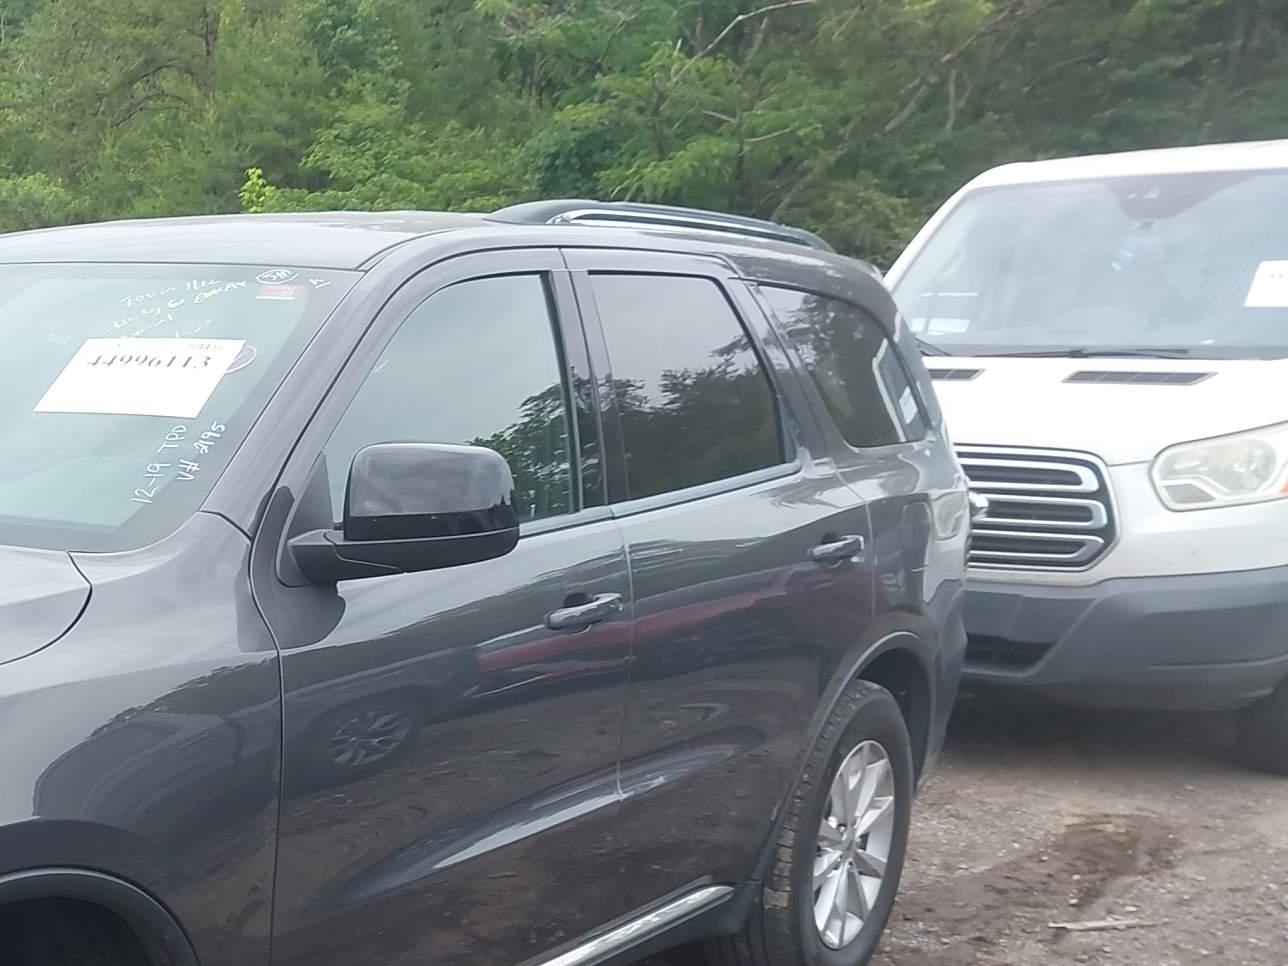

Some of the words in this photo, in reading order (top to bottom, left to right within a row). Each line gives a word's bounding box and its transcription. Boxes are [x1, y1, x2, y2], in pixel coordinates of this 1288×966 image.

[86, 354, 211, 368] 44996113
[193, 420, 226, 455] 2195
[129, 463, 171, 503] 12-19
